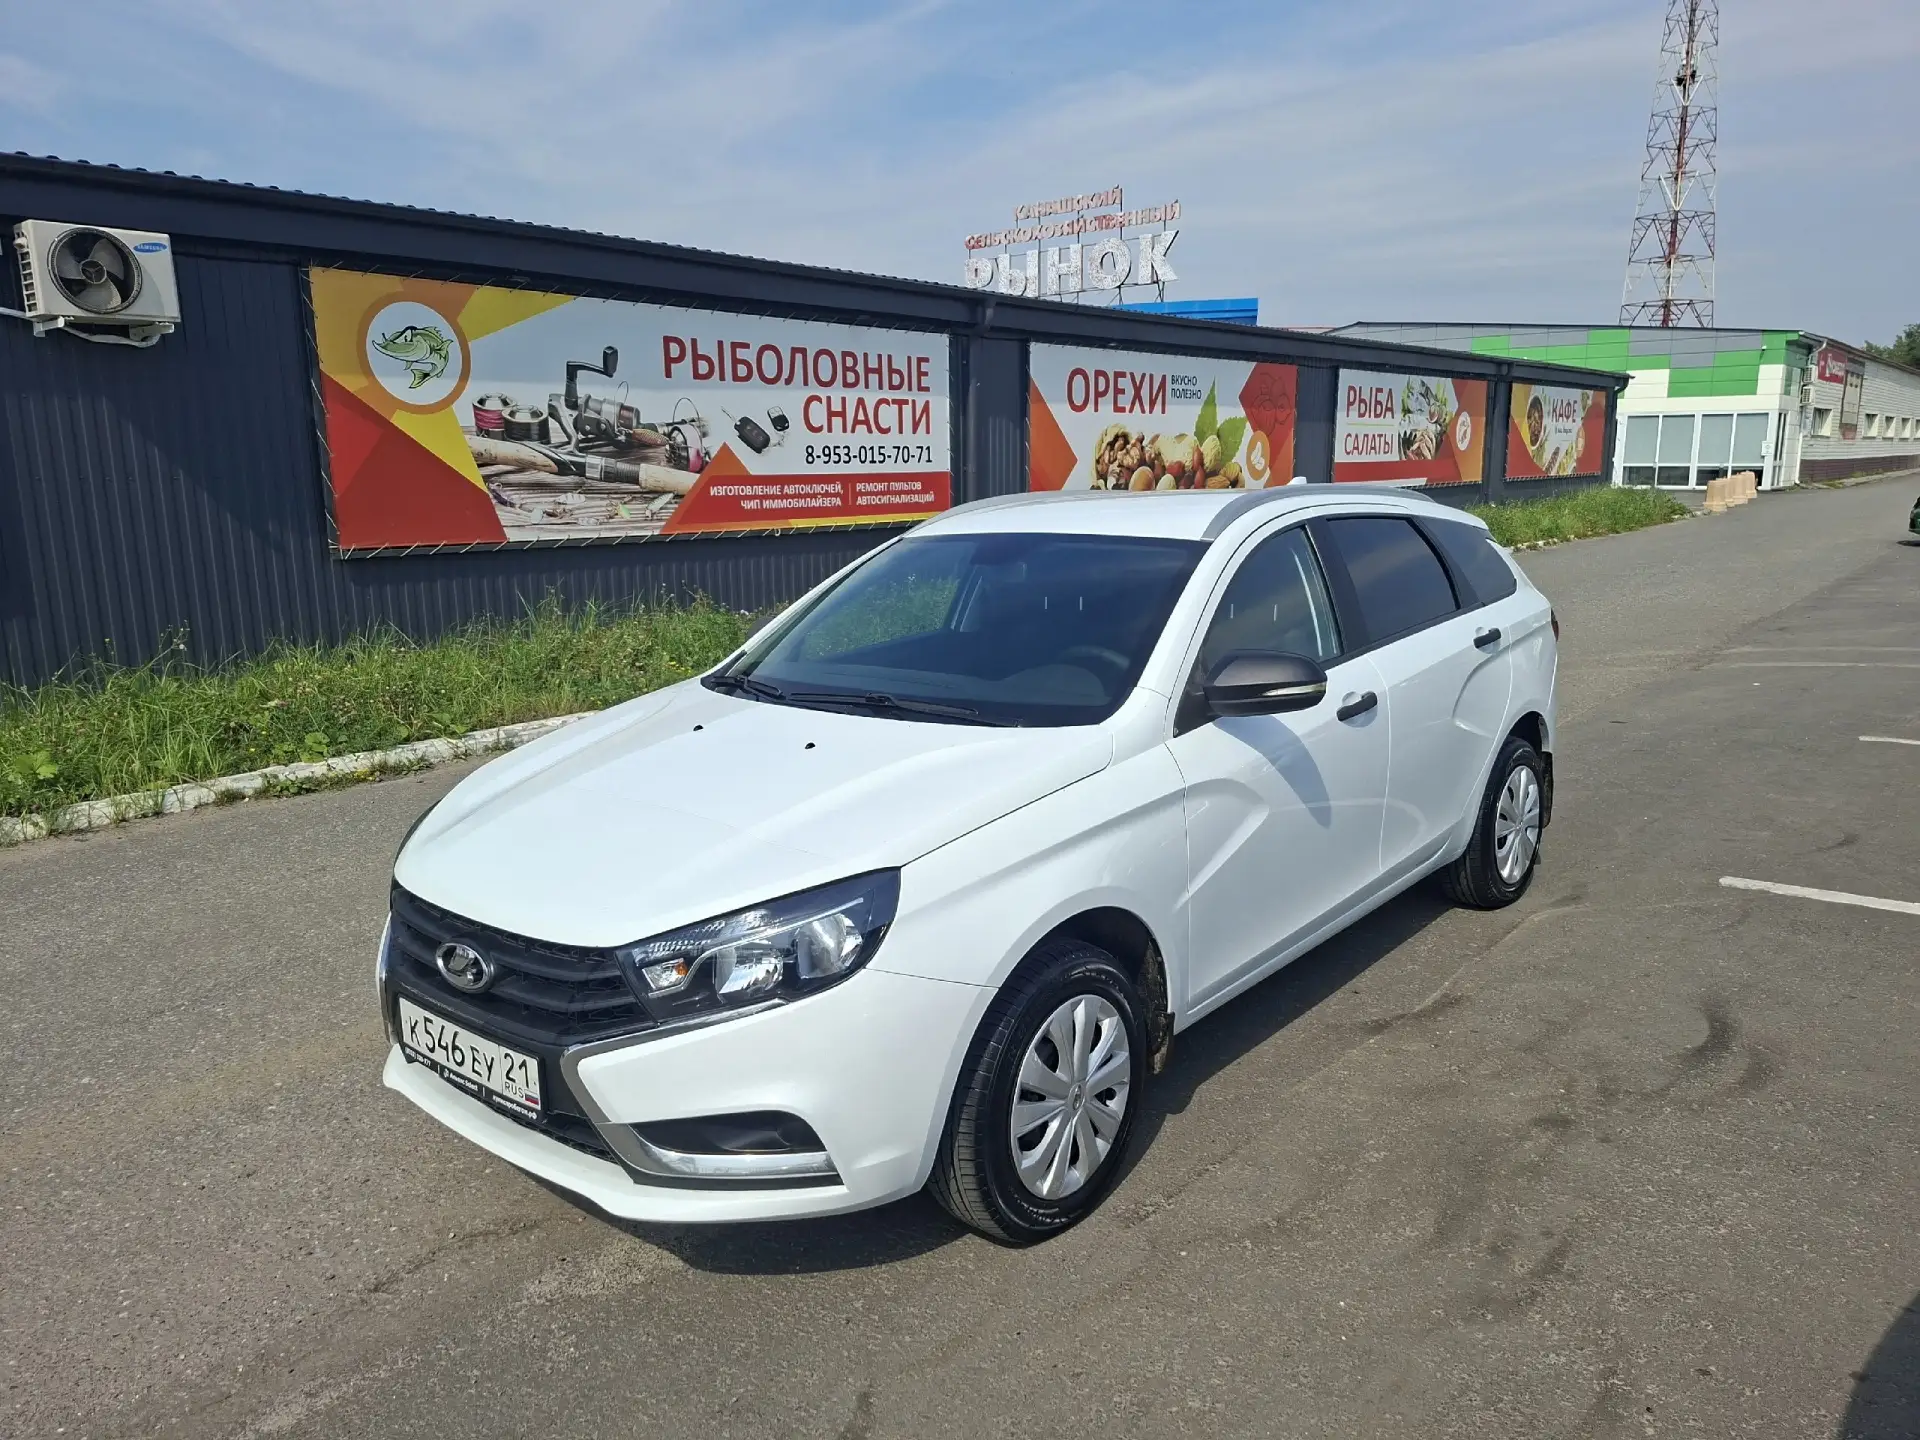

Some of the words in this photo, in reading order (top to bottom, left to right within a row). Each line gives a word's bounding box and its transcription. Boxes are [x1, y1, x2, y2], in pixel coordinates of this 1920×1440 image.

[965, 199, 1181, 250] СЕЛЬСКОХОЗЯЙСТВЕННЫЙ
[964, 230, 1180, 298] РЫНОК
[662, 335, 931, 392] РЫБОЛОВНЫЕ
[1067, 367, 1167, 414] ОРЕХИ
[1171, 374, 1198, 386] ВКУСНО
[1170, 388, 1202, 399] ПОЛЕЗНО
[1346, 385, 1395, 420] РЫБА
[803, 395, 931, 435] СНАСТИ
[1551, 398, 1578, 423] КАФЕ
[805, 445, 933, 465] 8-953-015-70-71
[1344, 432, 1394, 455] САЛАТЫ
[710, 485, 781, 496] ИЗГОТОВЛЕНИЕ
[783, 482, 843, 495] АВТОКЛЮЧЕЙ,
[856, 482, 888, 492] РЕМОНТ
[890, 481, 922, 491] ПУЛЬТОВ
[741, 499, 760, 509] ЧИП
[763, 495, 842, 509] ИММОБИЛАЙЗЕРА
[856, 491, 935, 506] АВТОСИГНАЛИЗАЦИЙ
[503, 1052, 531, 1089] 21
[504, 1081, 524, 1099] RUS
